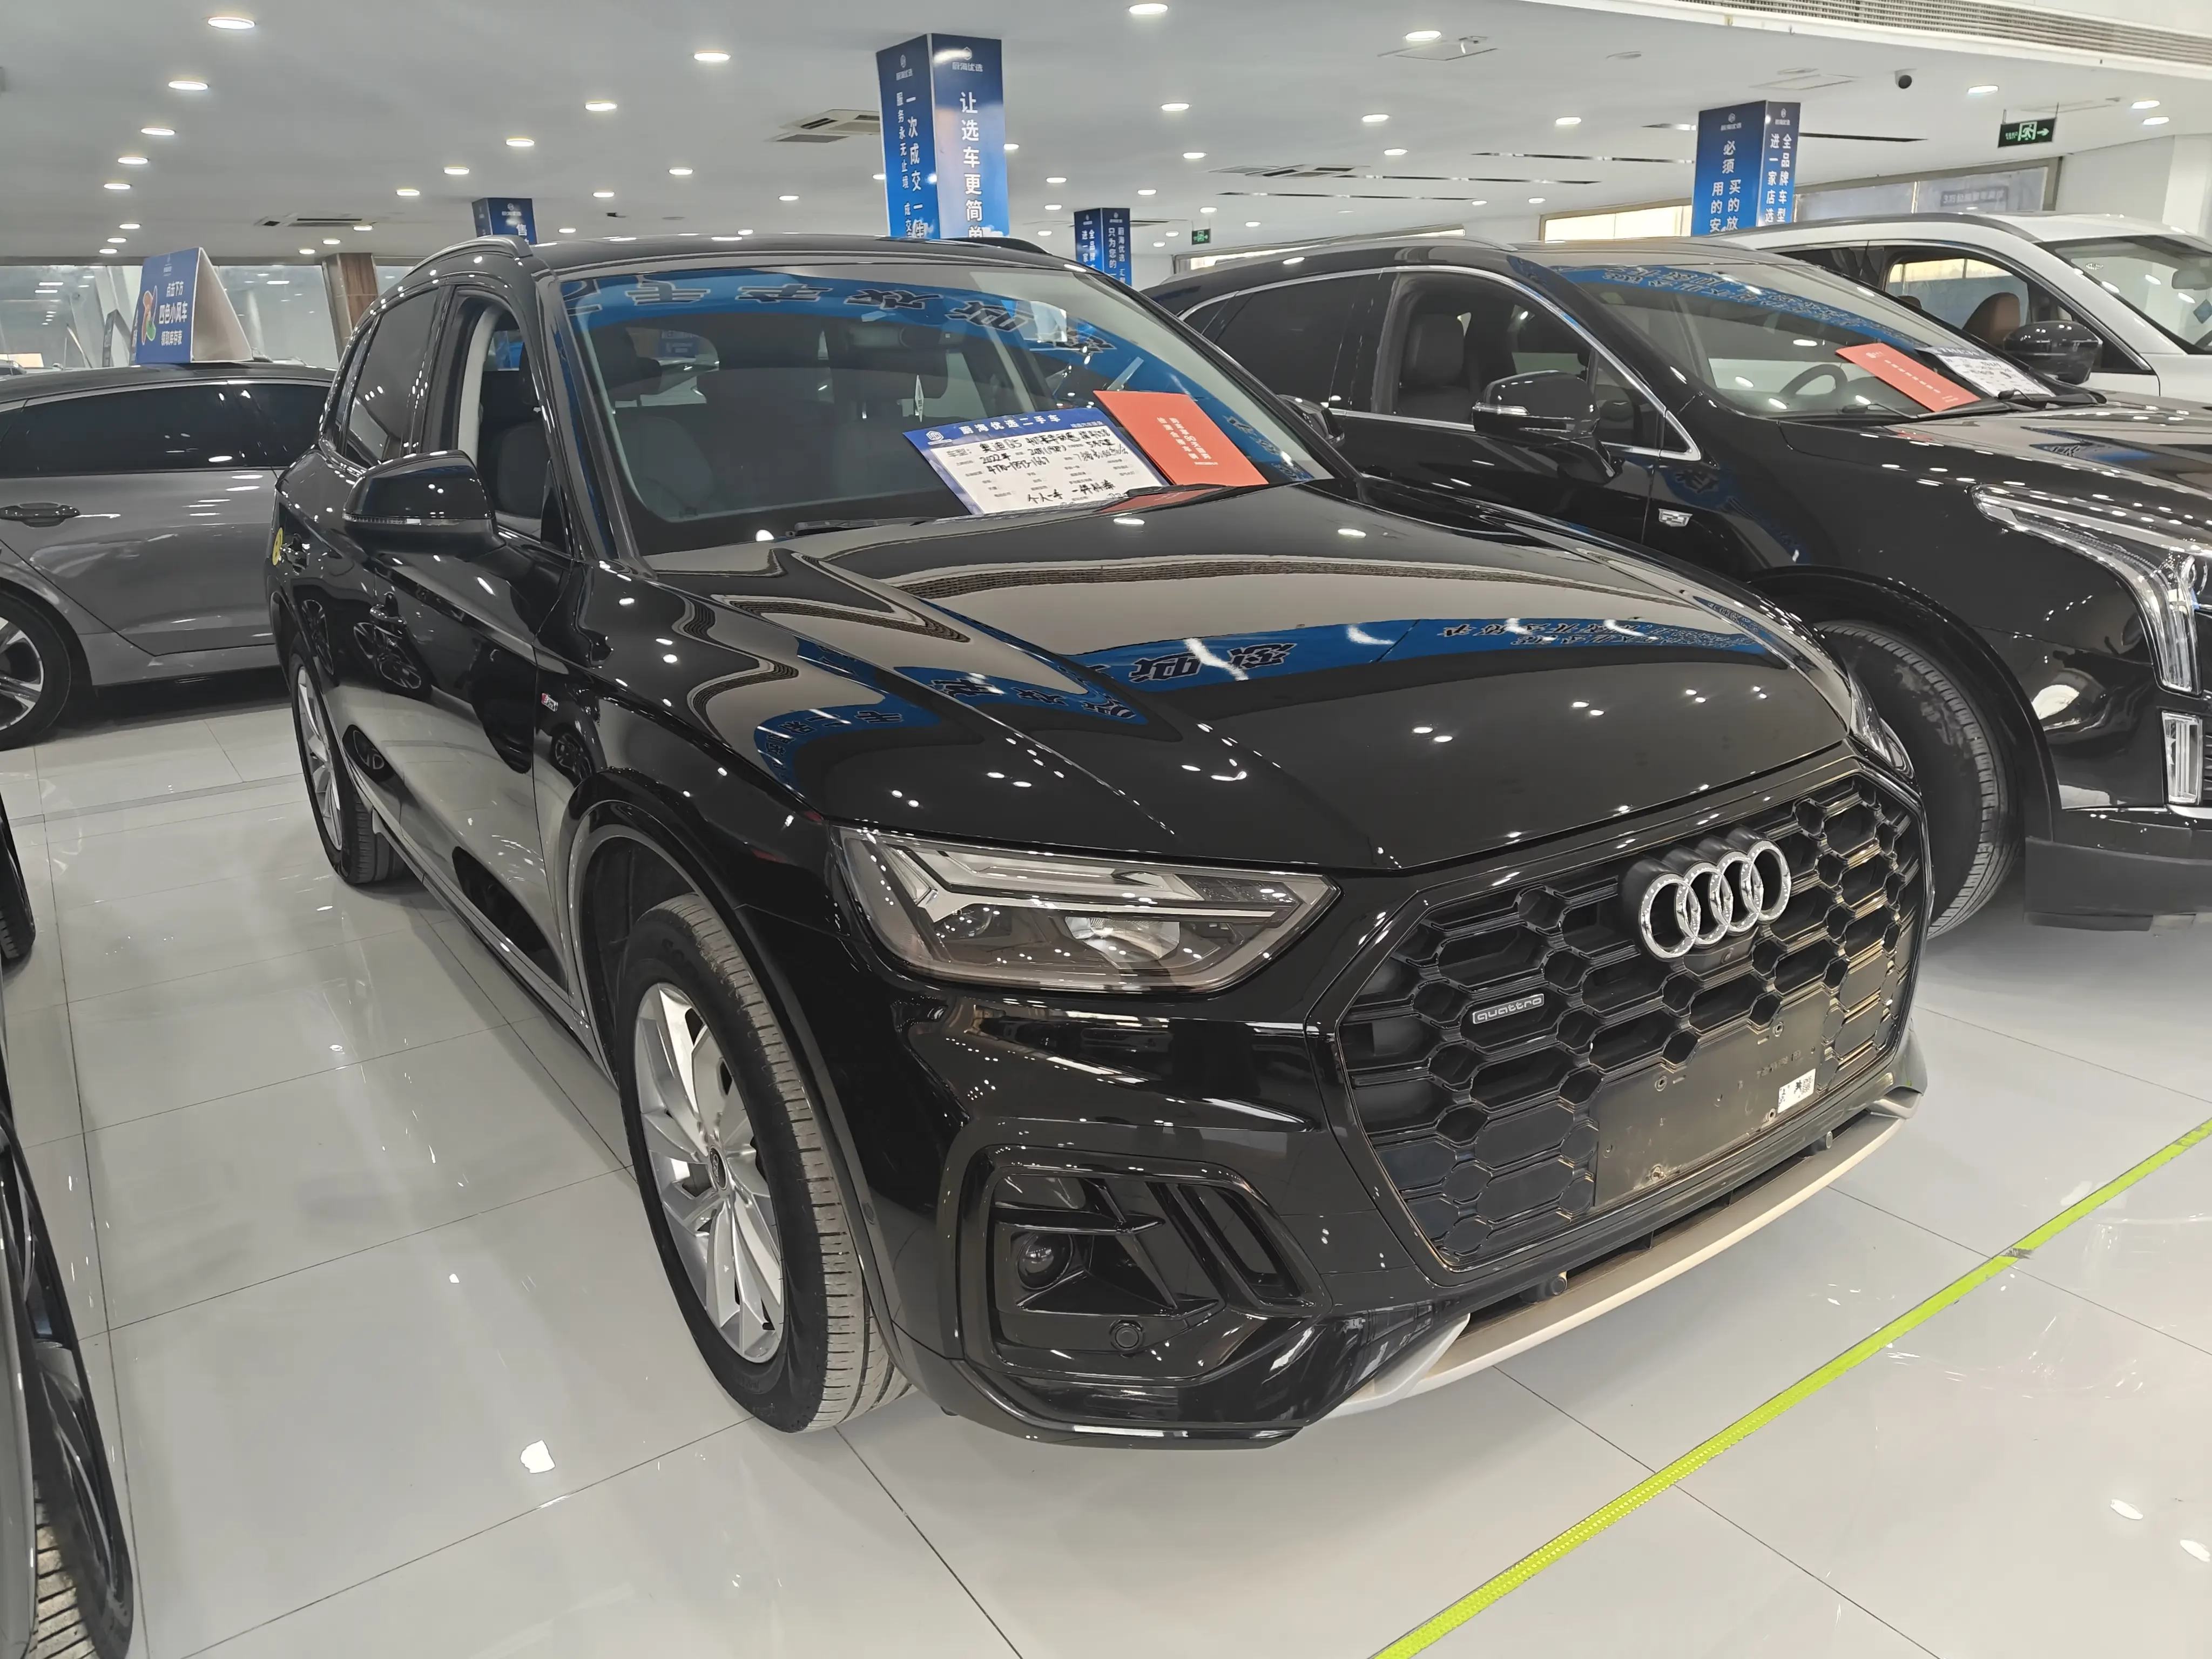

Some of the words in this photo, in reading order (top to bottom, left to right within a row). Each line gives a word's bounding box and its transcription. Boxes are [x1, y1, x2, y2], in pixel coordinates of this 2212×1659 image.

[906, 96, 921, 192] 一次成交
[1722, 140, 1736, 174] 必须
[1777, 133, 1792, 223] 全品牌车型
[166, 281, 184, 297] 点击下方
[158, 301, 188, 325] 四色小风车
[959, 414, 1061, 434] 蔚海优选二手车
[1476, 997, 1542, 1021] quattro
